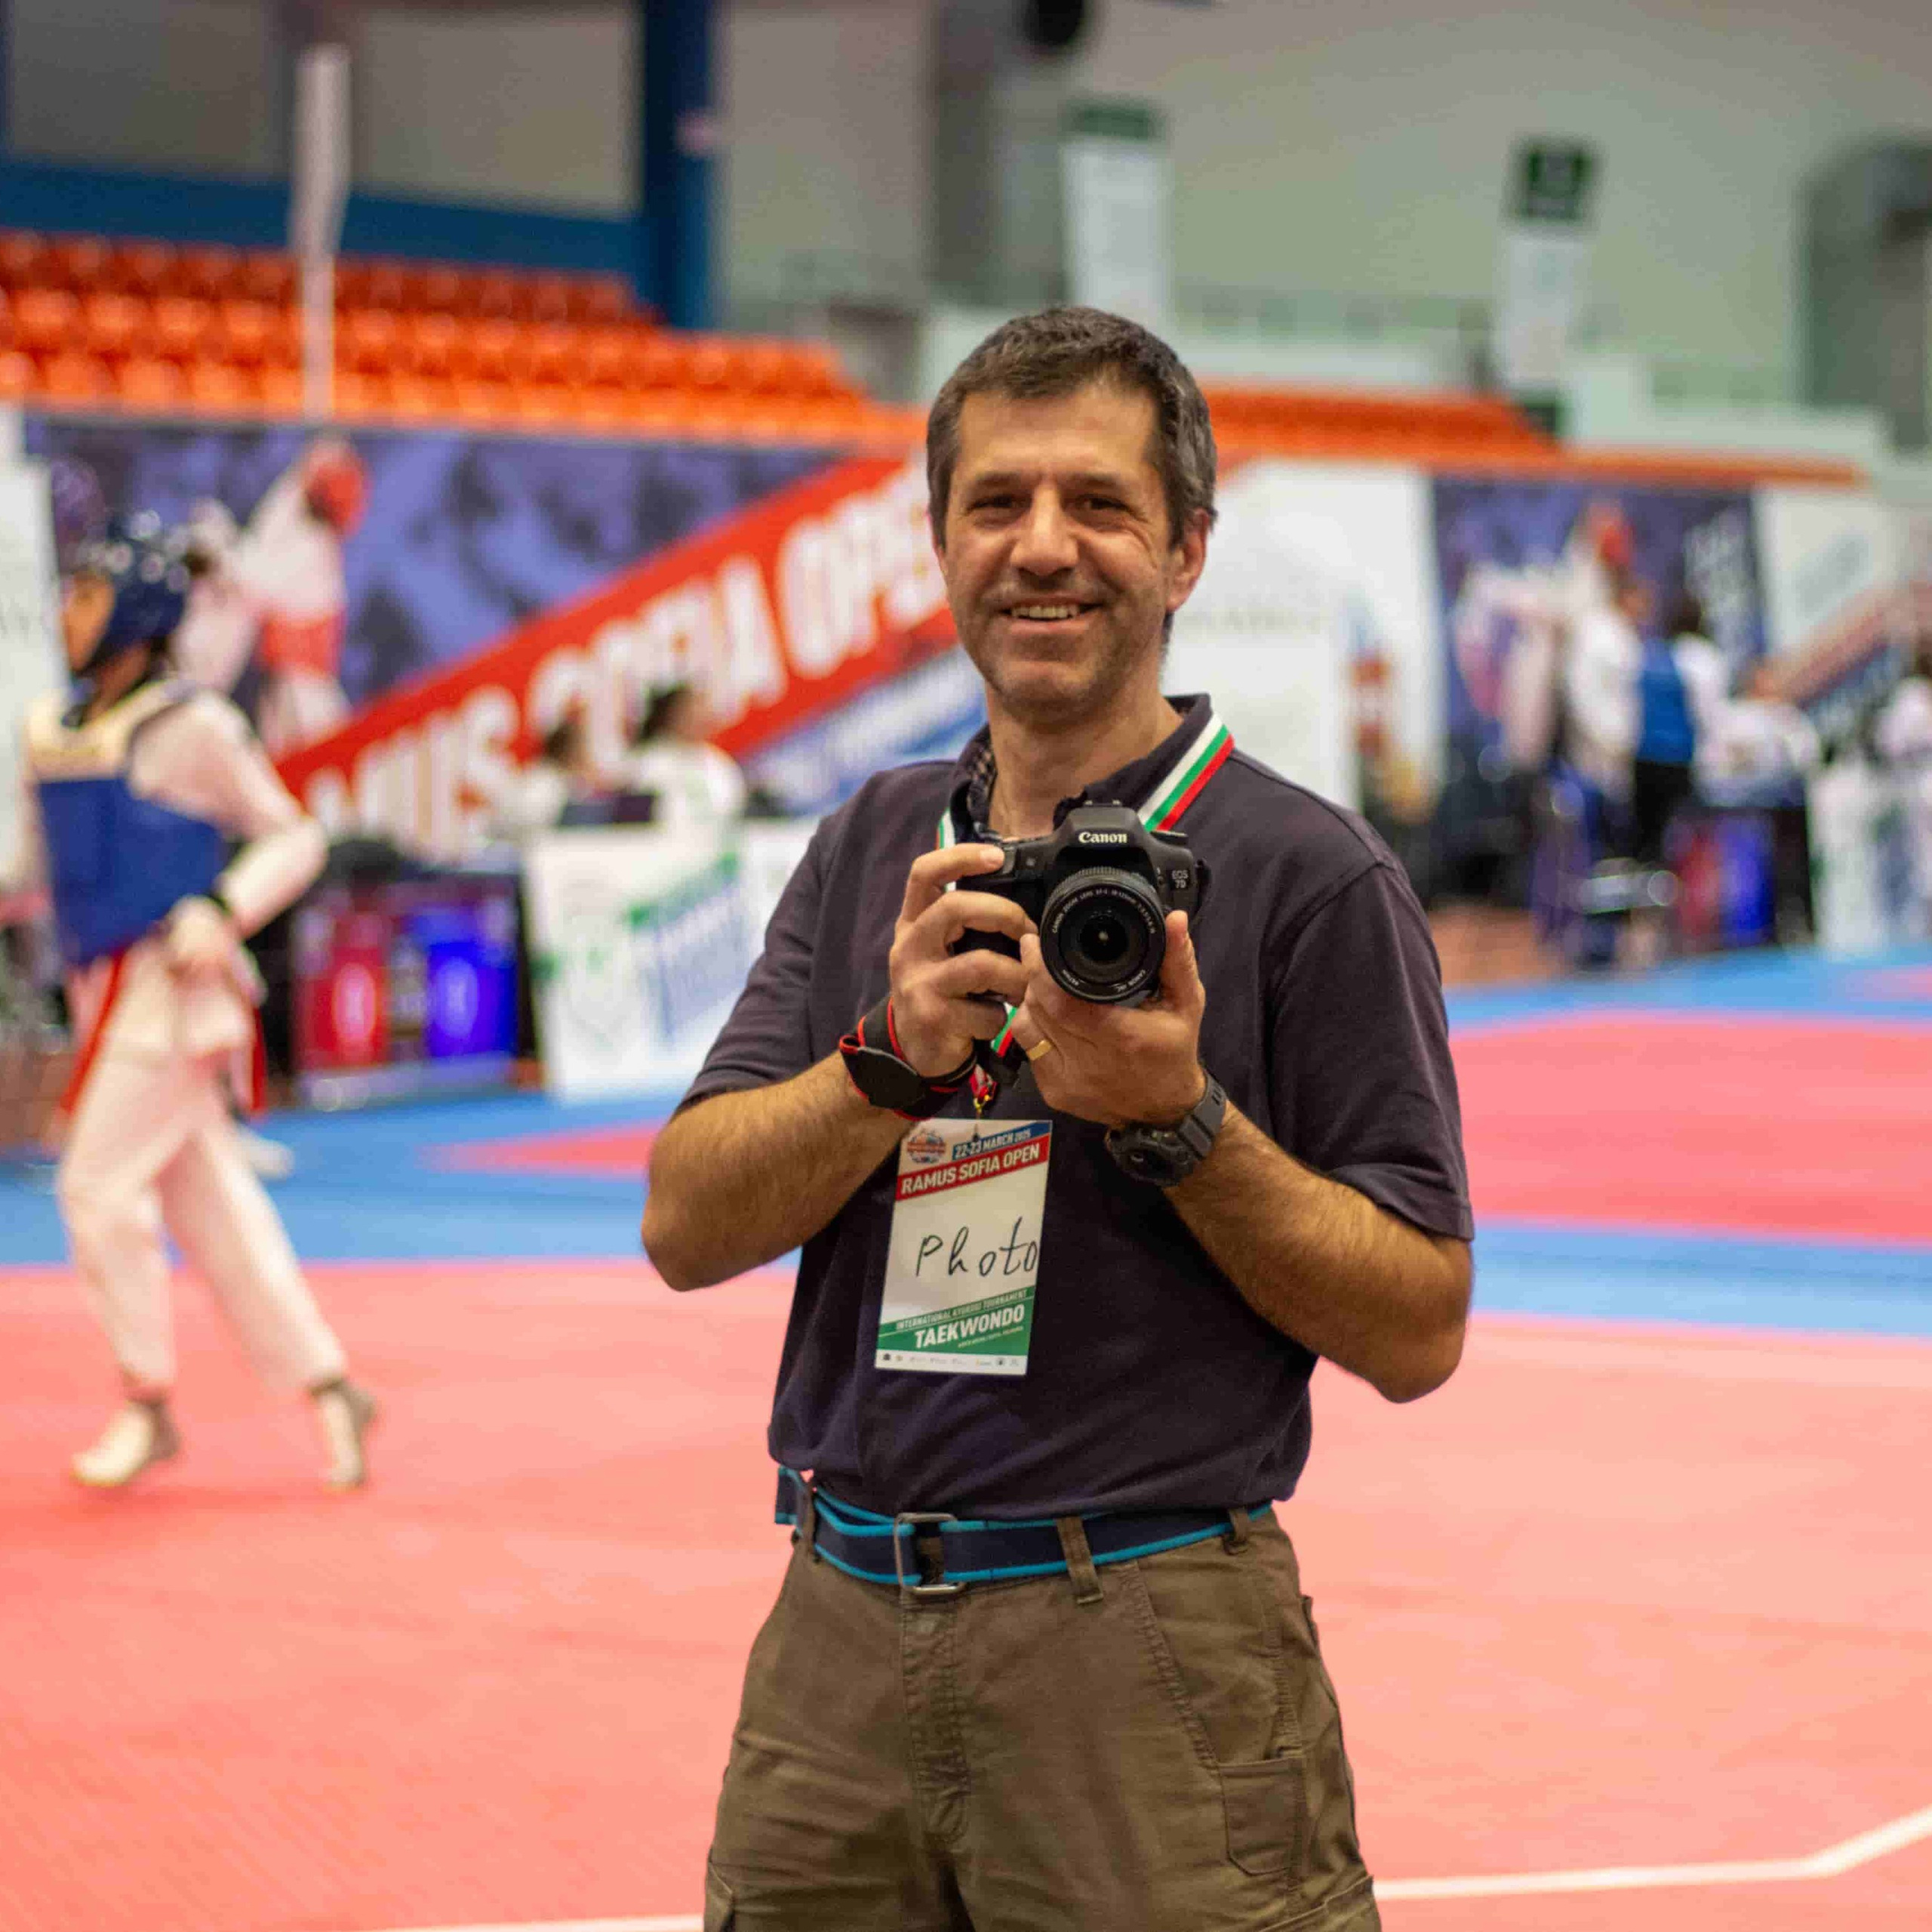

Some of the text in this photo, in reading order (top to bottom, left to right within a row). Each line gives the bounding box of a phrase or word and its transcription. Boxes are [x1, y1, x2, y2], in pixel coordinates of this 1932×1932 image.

[1078, 832, 1128, 843] Canon
[955, 1139, 982, 1158] 22-23
[983, 1132, 1014, 1151] MARCH
[901, 1143, 1040, 1195] RAMUS SOFIA OPEN
[916, 1217, 1038, 1277] Photo
[915, 1304, 1026, 1349] TAEKWONDO
